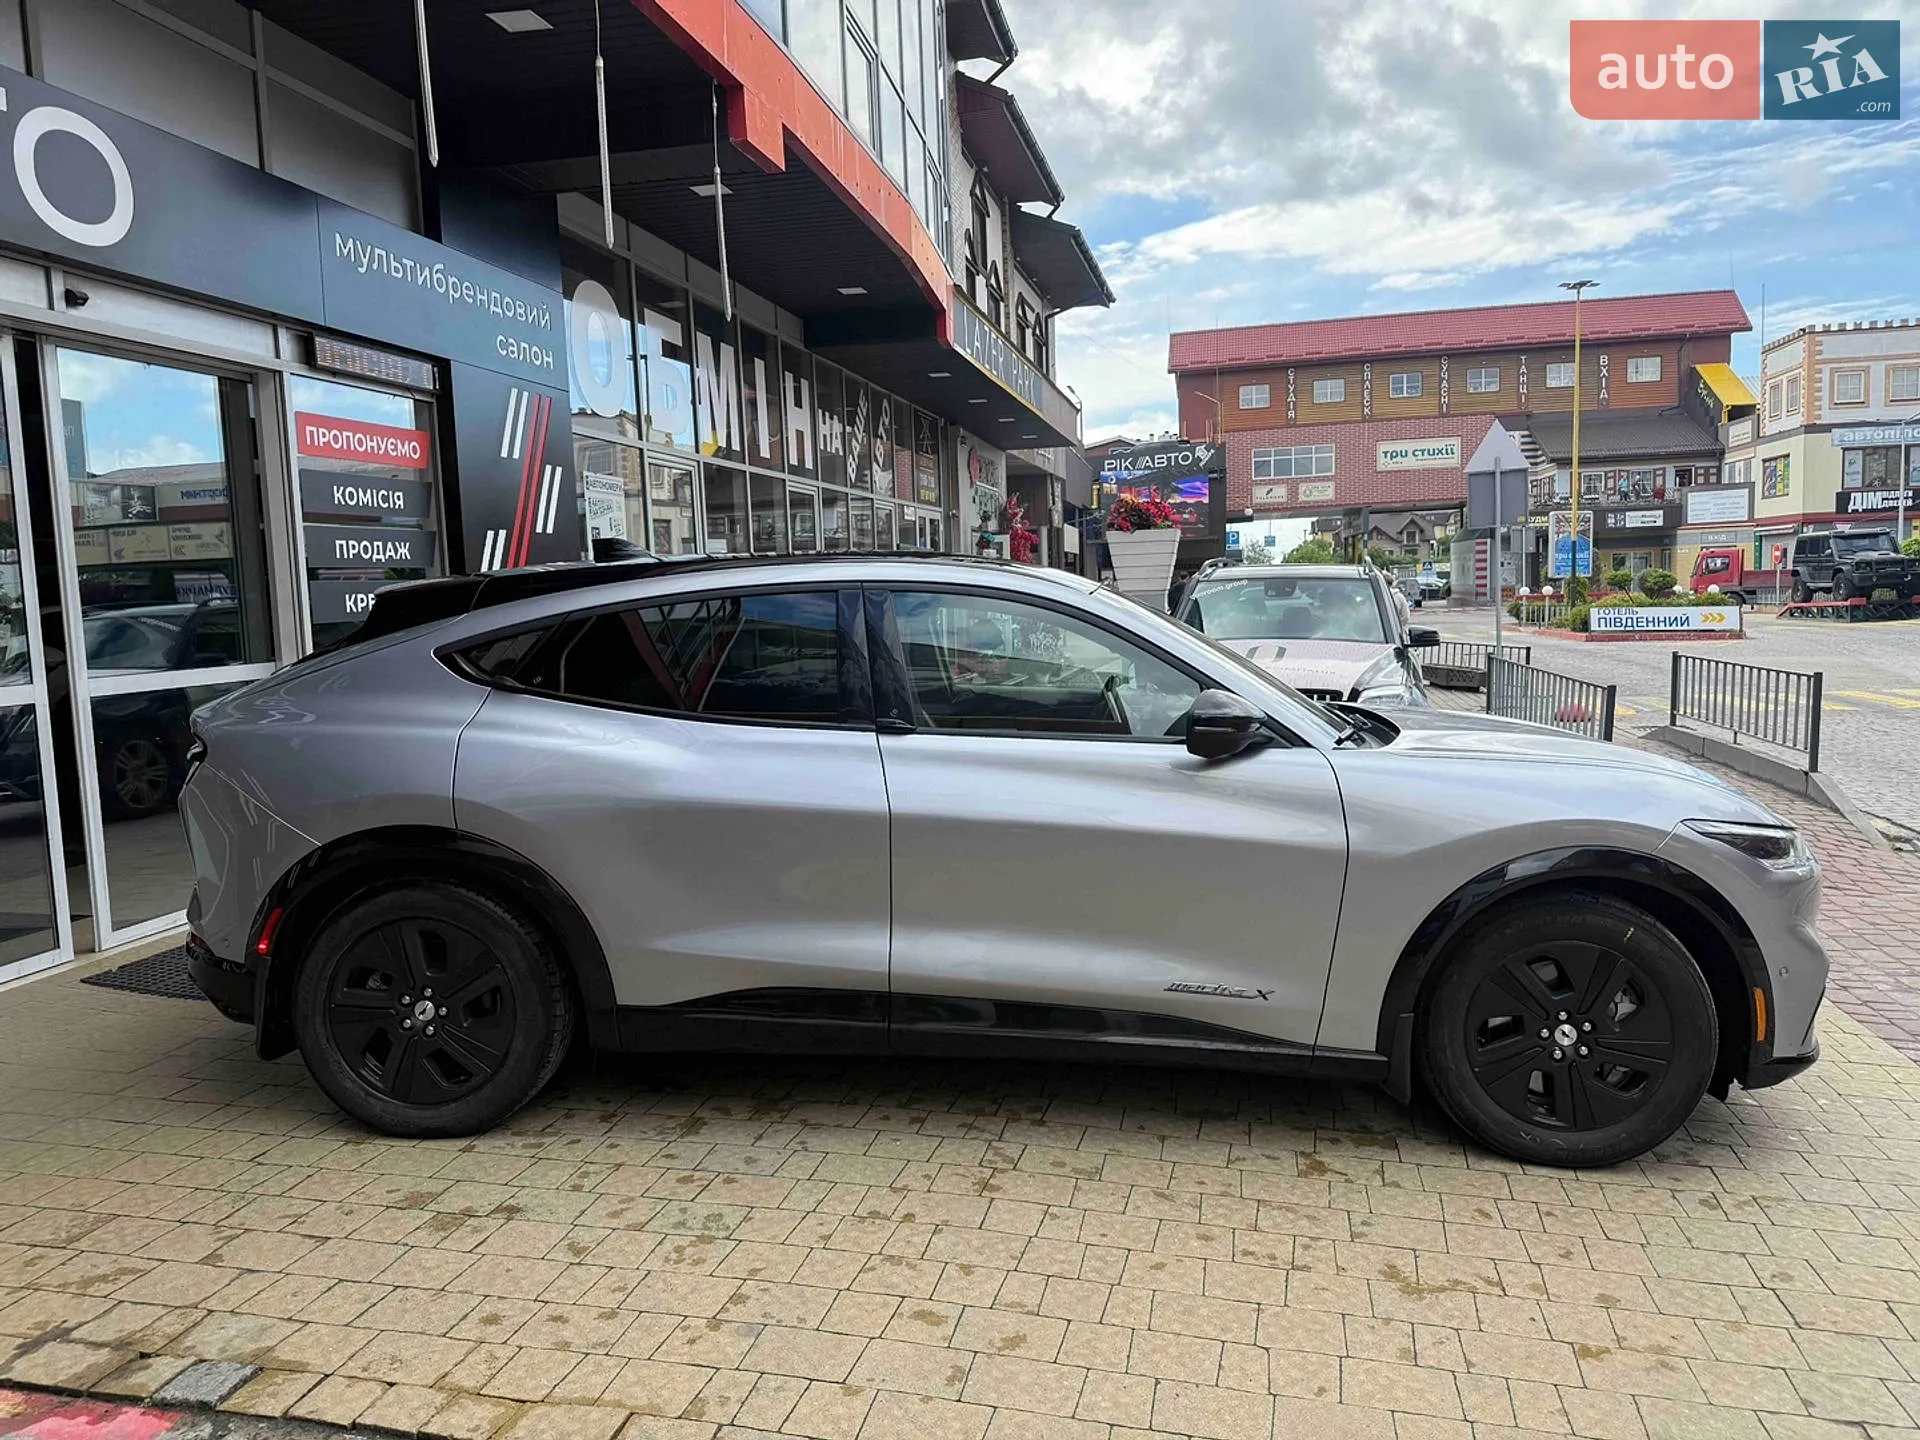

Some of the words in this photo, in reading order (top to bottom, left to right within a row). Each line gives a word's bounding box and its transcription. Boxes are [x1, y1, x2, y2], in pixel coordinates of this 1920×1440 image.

[335, 232, 552, 330] мультибрендовий
[496, 334, 555, 370] салон
[571, 280, 814, 470] ОБМІН
[817, 408, 844, 456] НА
[1287, 368, 1295, 419] СТУДІЯ
[305, 425, 420, 460] ПРОПОНУЄМО
[333, 485, 404, 510] КОМІСІЯ
[1848, 492, 1882, 513] ДІМ
[335, 540, 411, 562] ПРОДАЖ
[1597, 607, 1638, 616] ГОТЕЛЬ
[1597, 612, 1690, 630] ПІВДЕННИЙ
